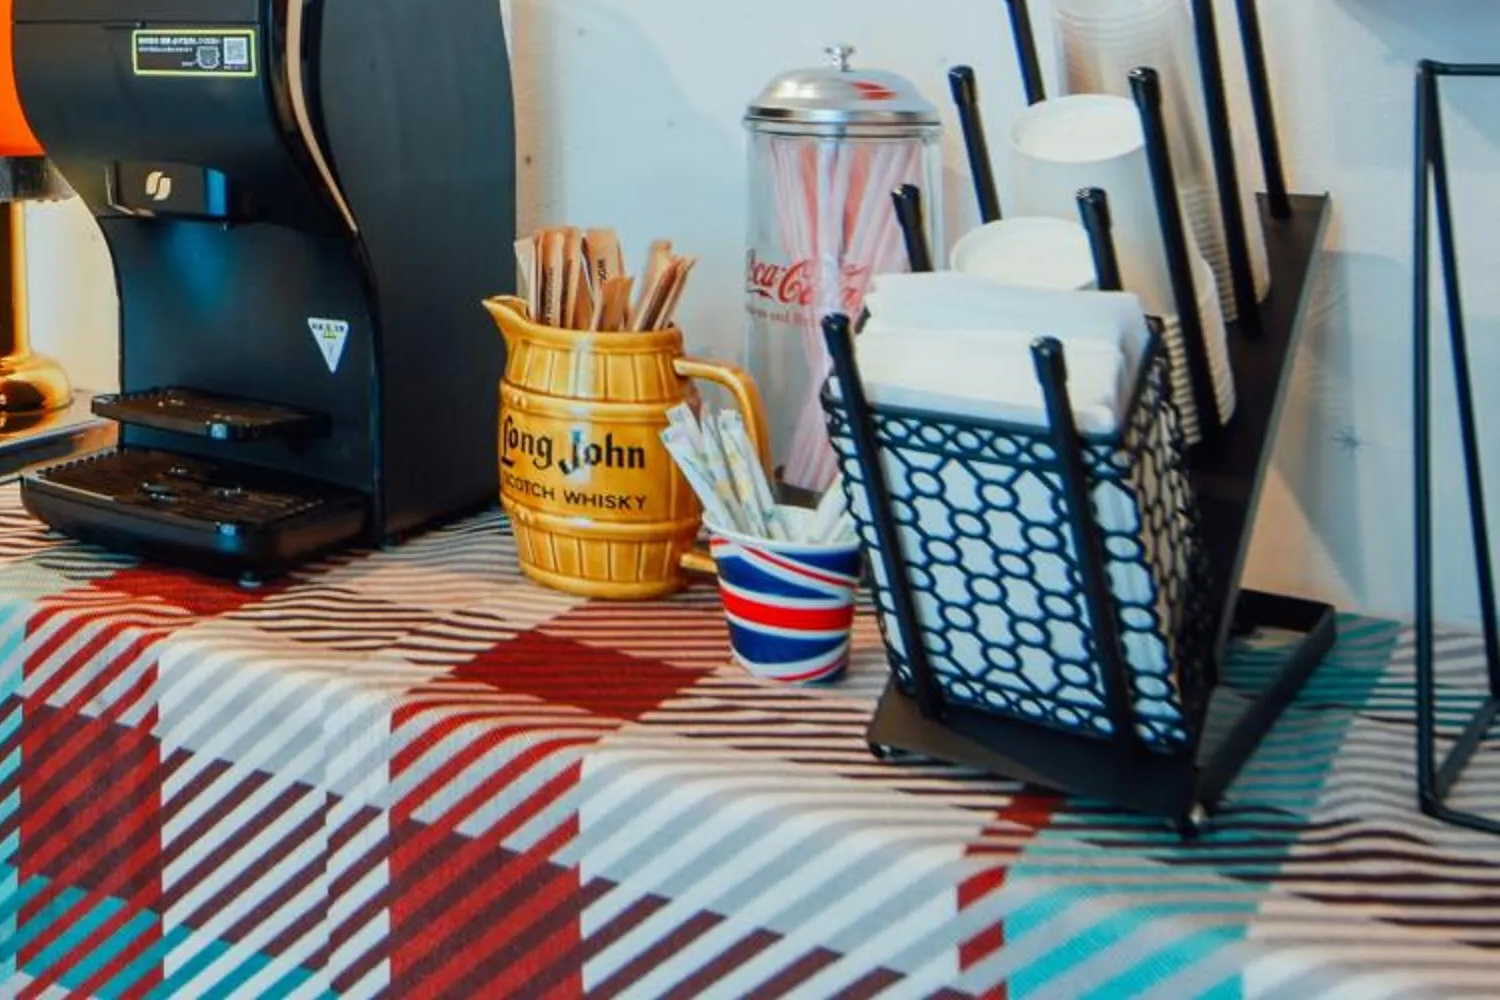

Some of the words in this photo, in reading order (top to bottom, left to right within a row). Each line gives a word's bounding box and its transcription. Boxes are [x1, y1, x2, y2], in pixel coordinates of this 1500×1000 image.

[501, 414, 553, 470] Long
[558, 427, 646, 476] John
[563, 489, 647, 511] WHISKY
